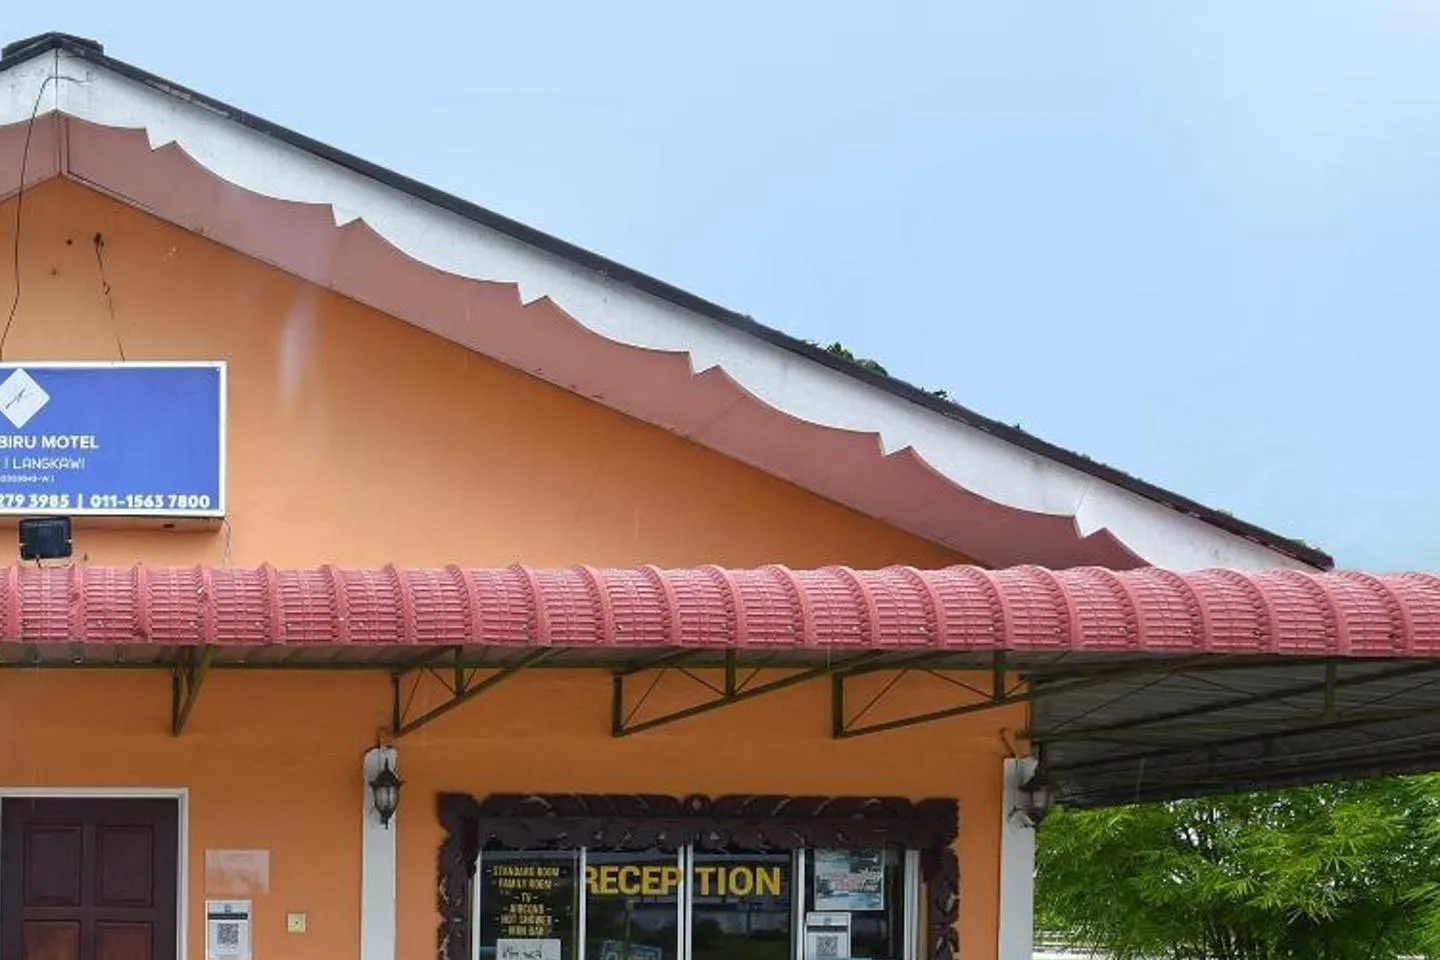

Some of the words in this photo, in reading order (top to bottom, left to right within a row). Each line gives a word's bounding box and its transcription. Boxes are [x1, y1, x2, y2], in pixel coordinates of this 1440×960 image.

[41, 435, 100, 449] MOTEL
[28, 494, 70, 508] 3985
[90, 494, 164, 509] 011-1563
[168, 494, 211, 509] 7800
